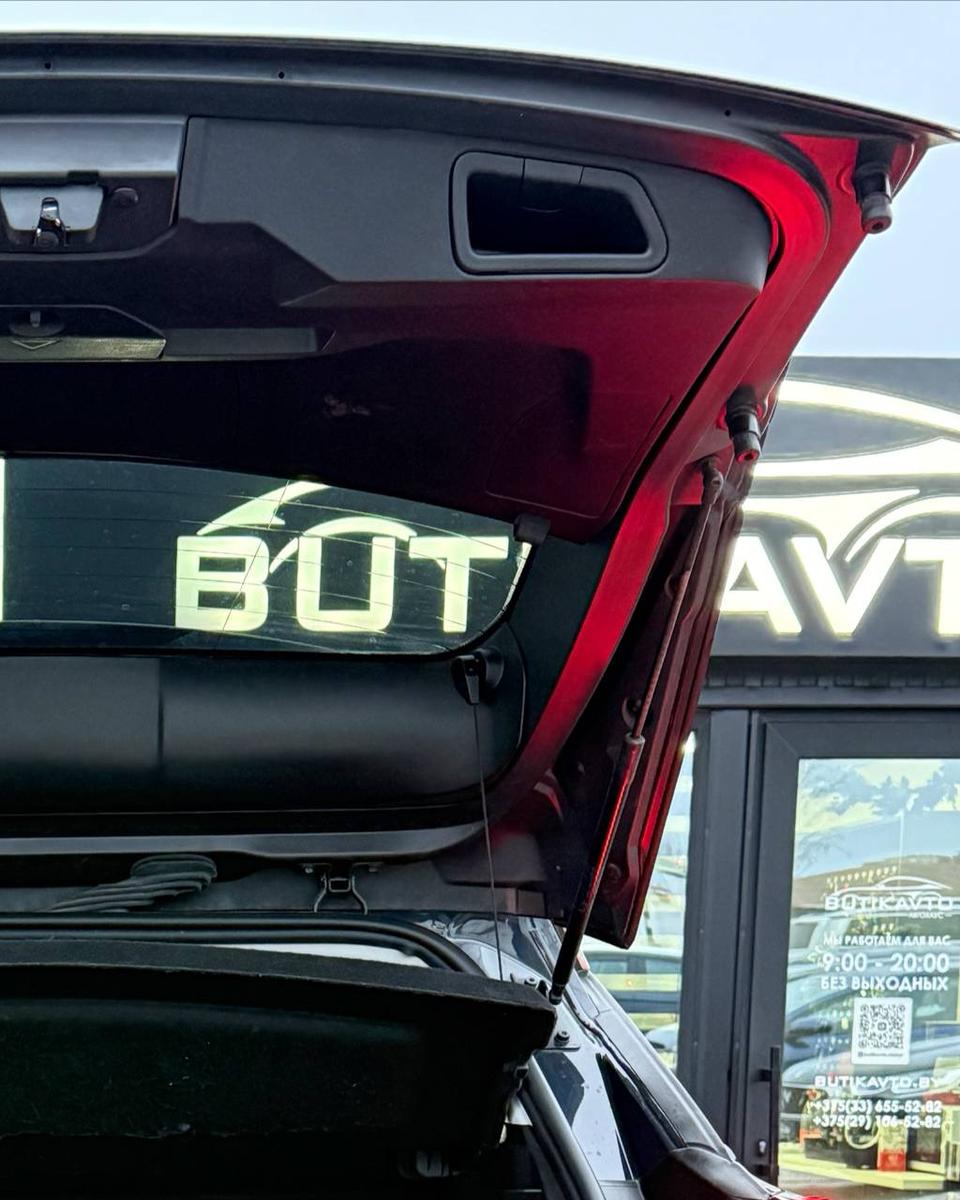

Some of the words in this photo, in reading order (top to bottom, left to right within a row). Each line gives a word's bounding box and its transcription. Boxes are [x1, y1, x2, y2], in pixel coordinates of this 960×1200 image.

[175, 536, 509, 633] BUT
[825, 896, 953, 911] BUTIKAVTO
[845, 934, 901, 946] РАБОТАЕМ
[903, 935, 926, 946] ДЛЯ
[928, 934, 951, 946] ВАС
[822, 953, 867, 972] 9:00
[890, 953, 950, 973] 20:00
[821, 976, 848, 990] БЕЗ
[851, 976, 948, 992] ВЫХОДНЫХ
[814, 1075, 939, 1089] BUTIKAVTO.BY
[812, 1100, 872, 1114] +375(33)
[812, 1115, 872, 1130] +375(29)
